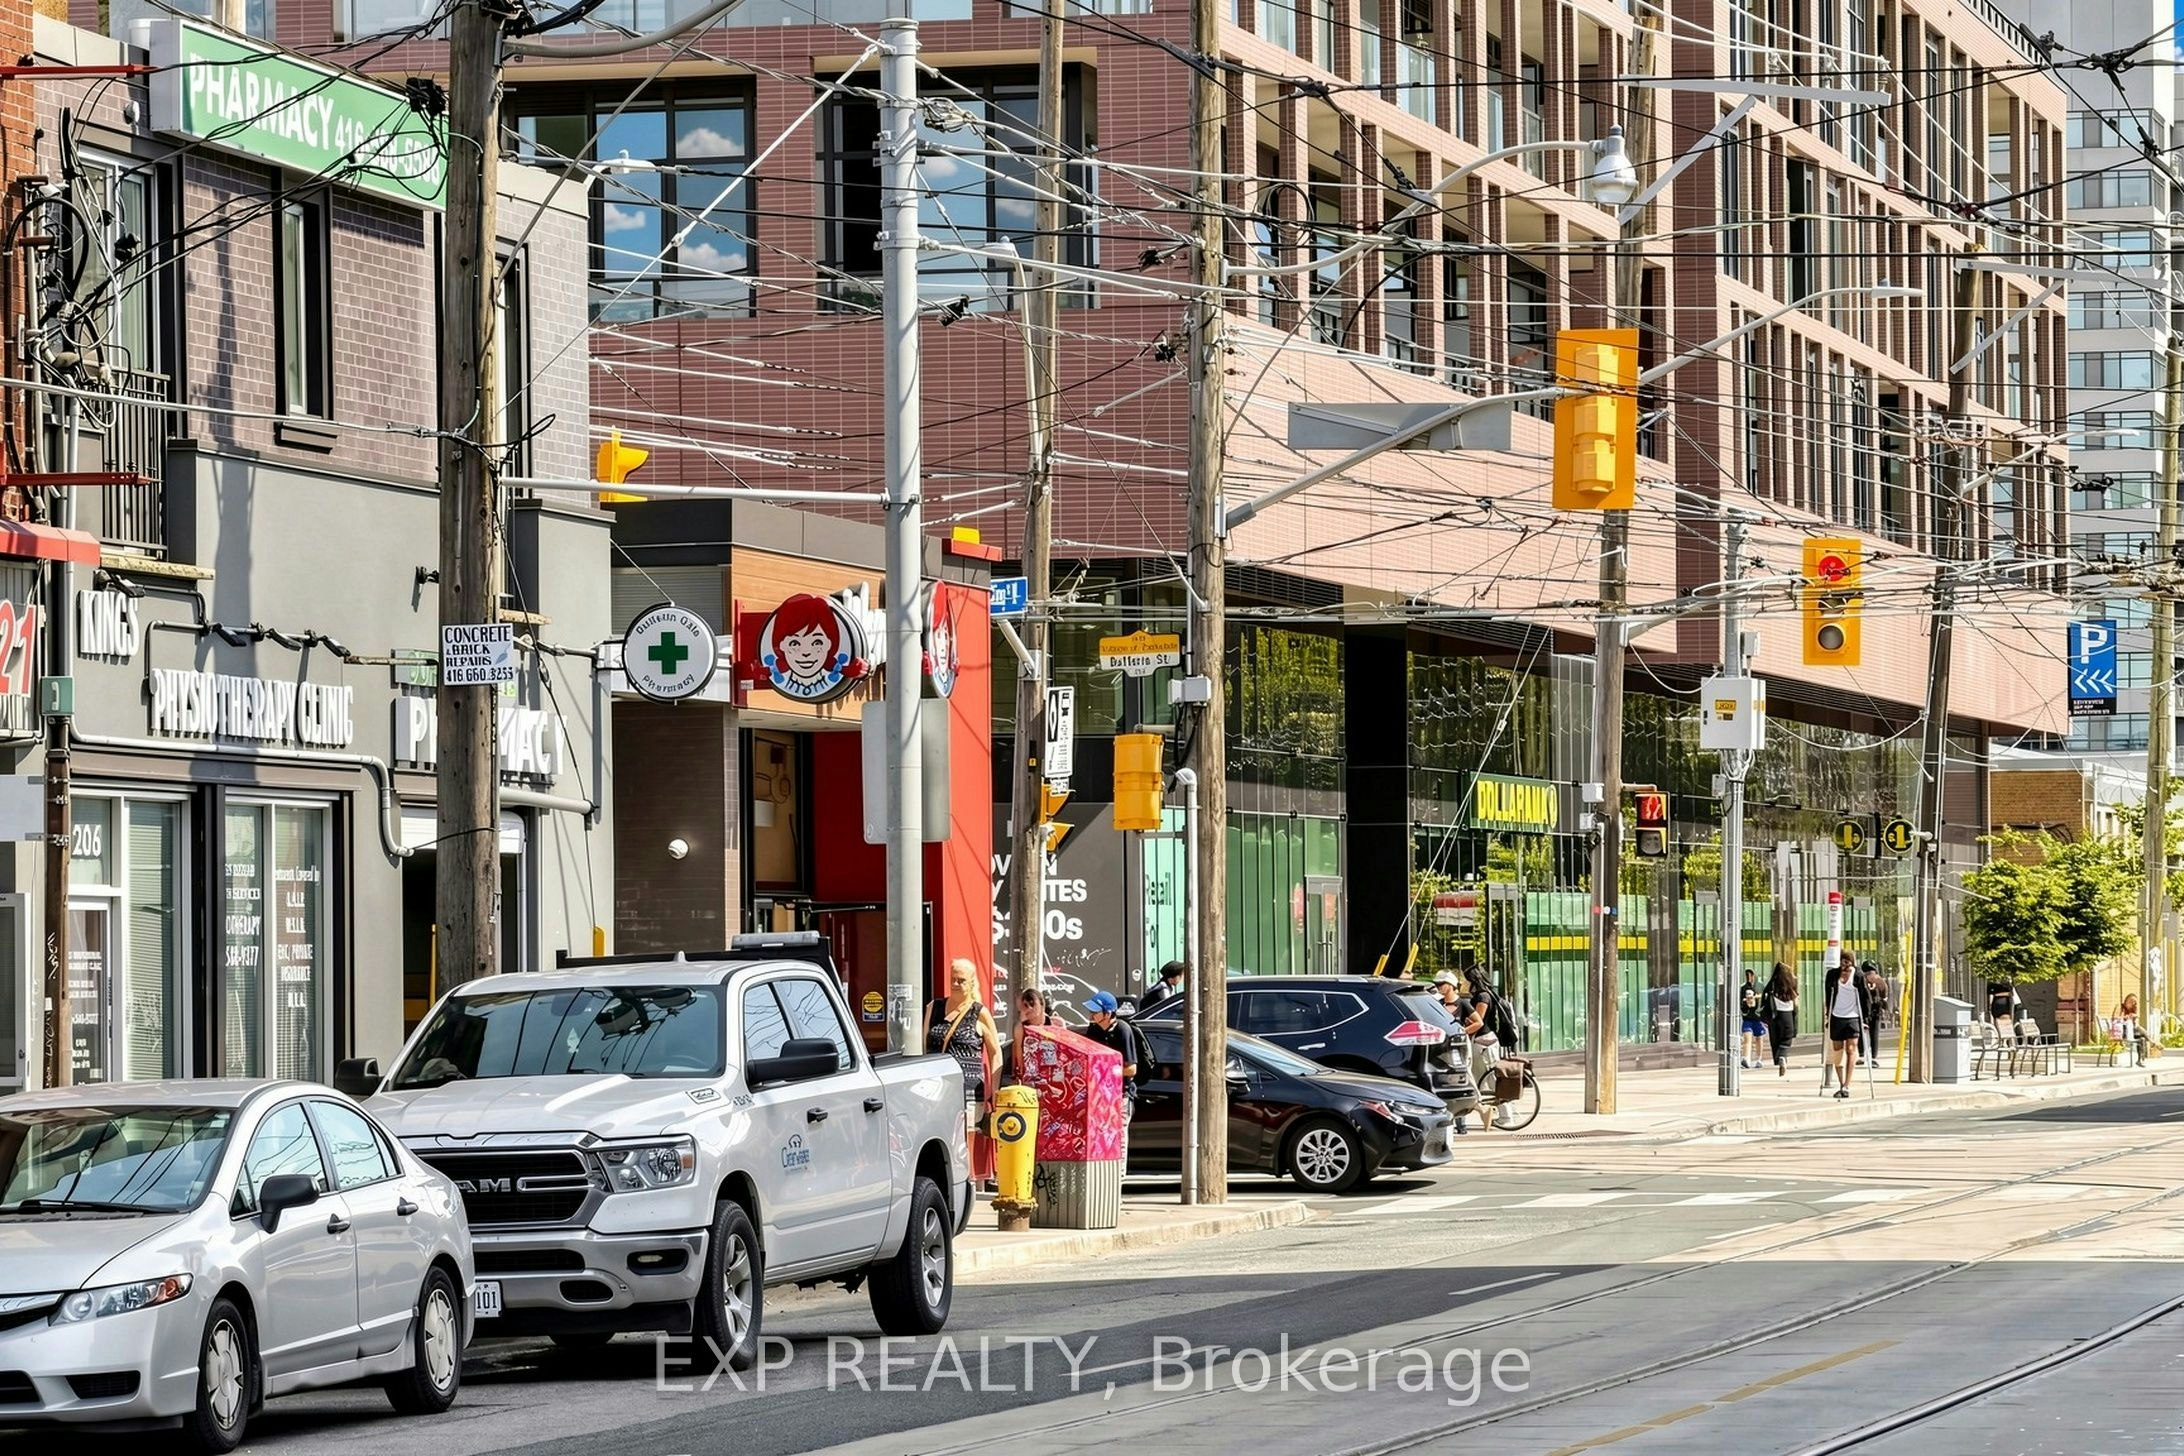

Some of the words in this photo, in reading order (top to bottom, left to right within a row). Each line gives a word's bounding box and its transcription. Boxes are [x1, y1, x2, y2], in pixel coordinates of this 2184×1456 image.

[189, 52, 334, 151] PHARMACY
[81, 589, 141, 657] KINGS
[444, 625, 512, 644] CONCRETE
[446, 656, 492, 667] REPAIRS
[452, 644, 491, 656] BRICK
[2080, 624, 2107, 664] P
[642, 673, 695, 693] Pharmacy
[151, 668, 298, 742] PHYSIOTHERAPY
[299, 681, 354, 745] CLINIC
[1477, 780, 1550, 826] DOLLARAMA
[72, 824, 102, 857] 206
